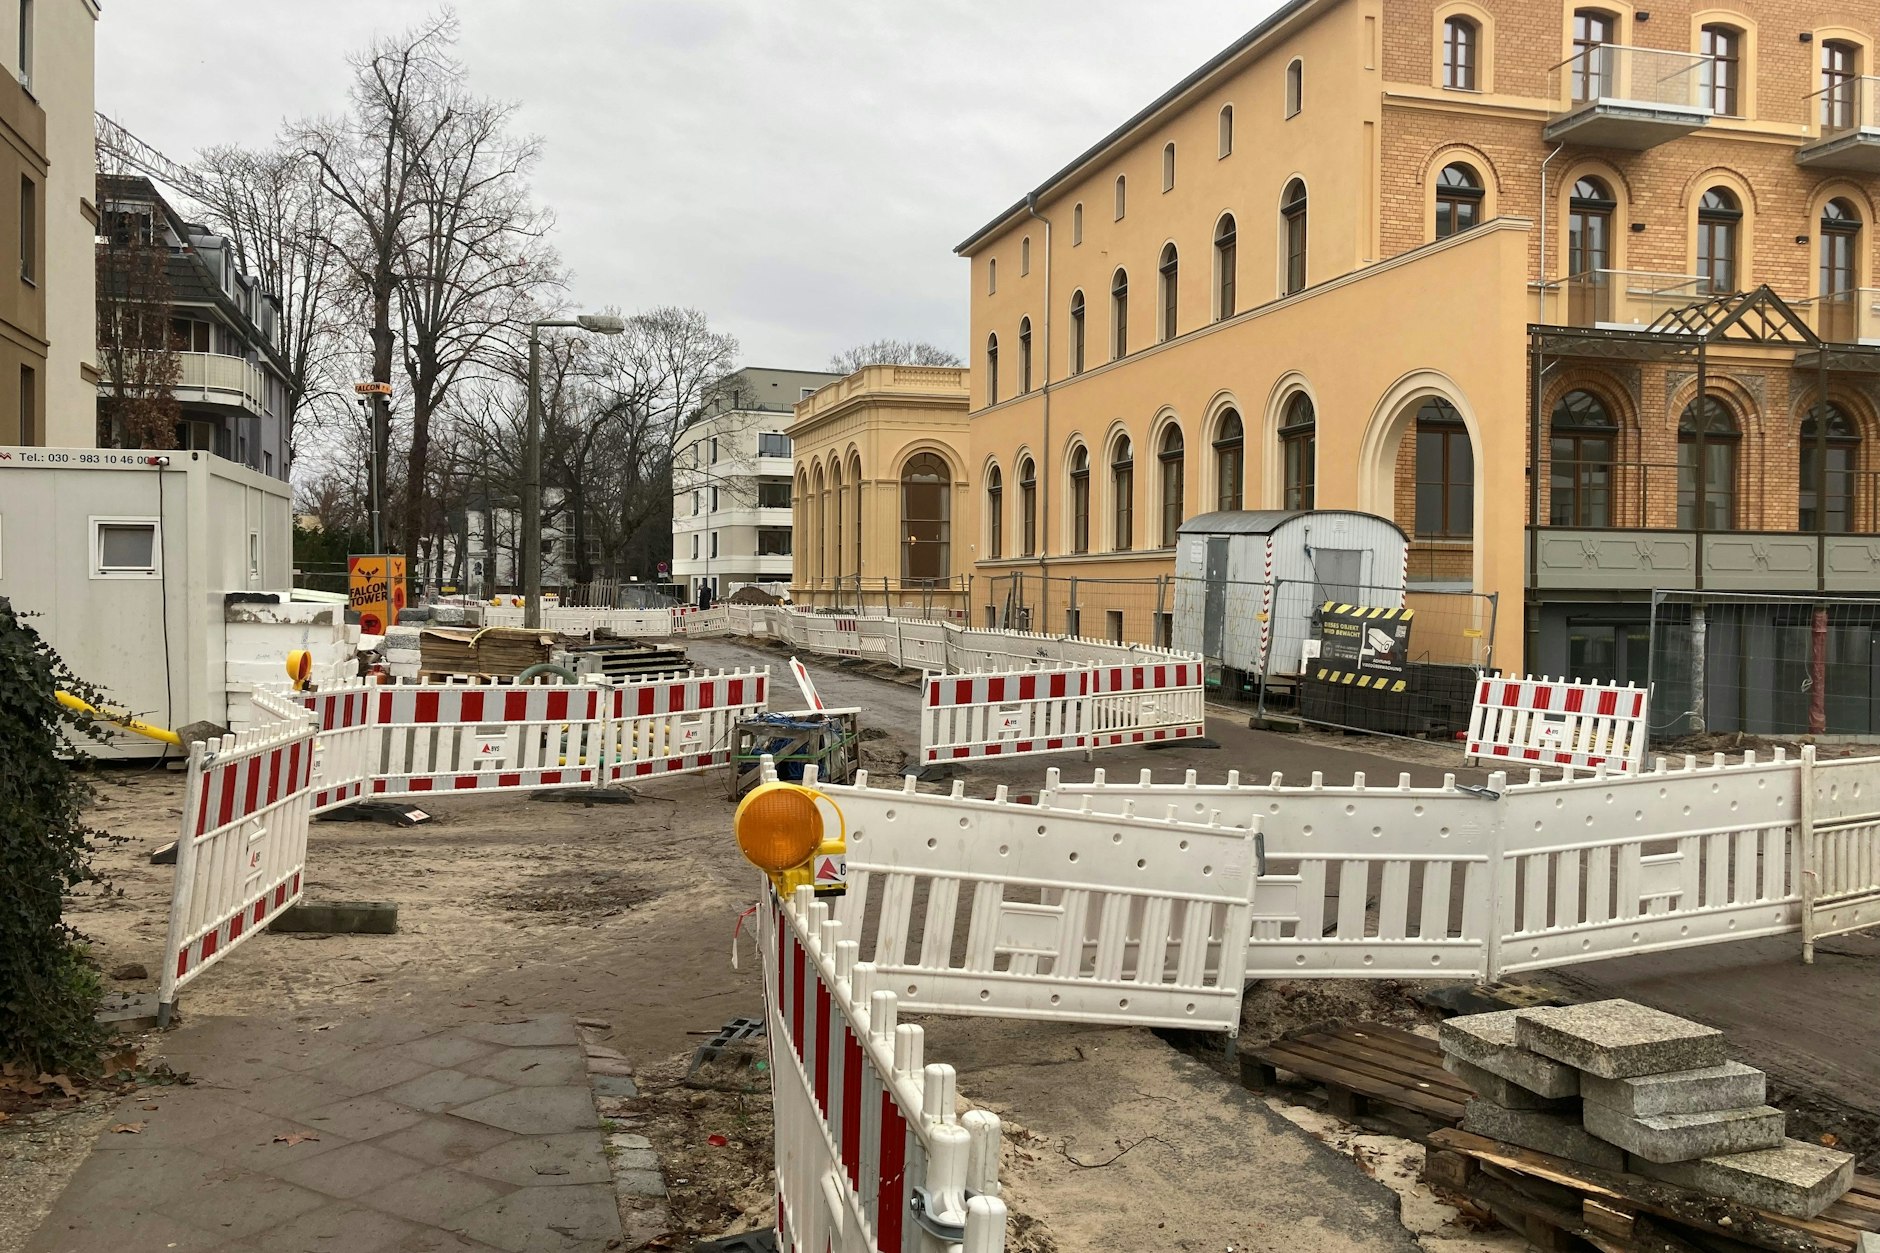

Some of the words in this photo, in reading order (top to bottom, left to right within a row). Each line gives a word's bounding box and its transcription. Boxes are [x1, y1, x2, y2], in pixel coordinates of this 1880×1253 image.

[355, 383, 380, 392] FALCON
[19, 452, 44, 462] Tel.:
[48, 453, 69, 463] 030
[79, 454, 100, 464] 983
[105, 455, 117, 464] 10
[120, 455, 133, 464] 46
[350, 581, 388, 598] FALCON
[350, 591, 388, 608] TOWER
[1340, 623, 1360, 631] OBJEKT
